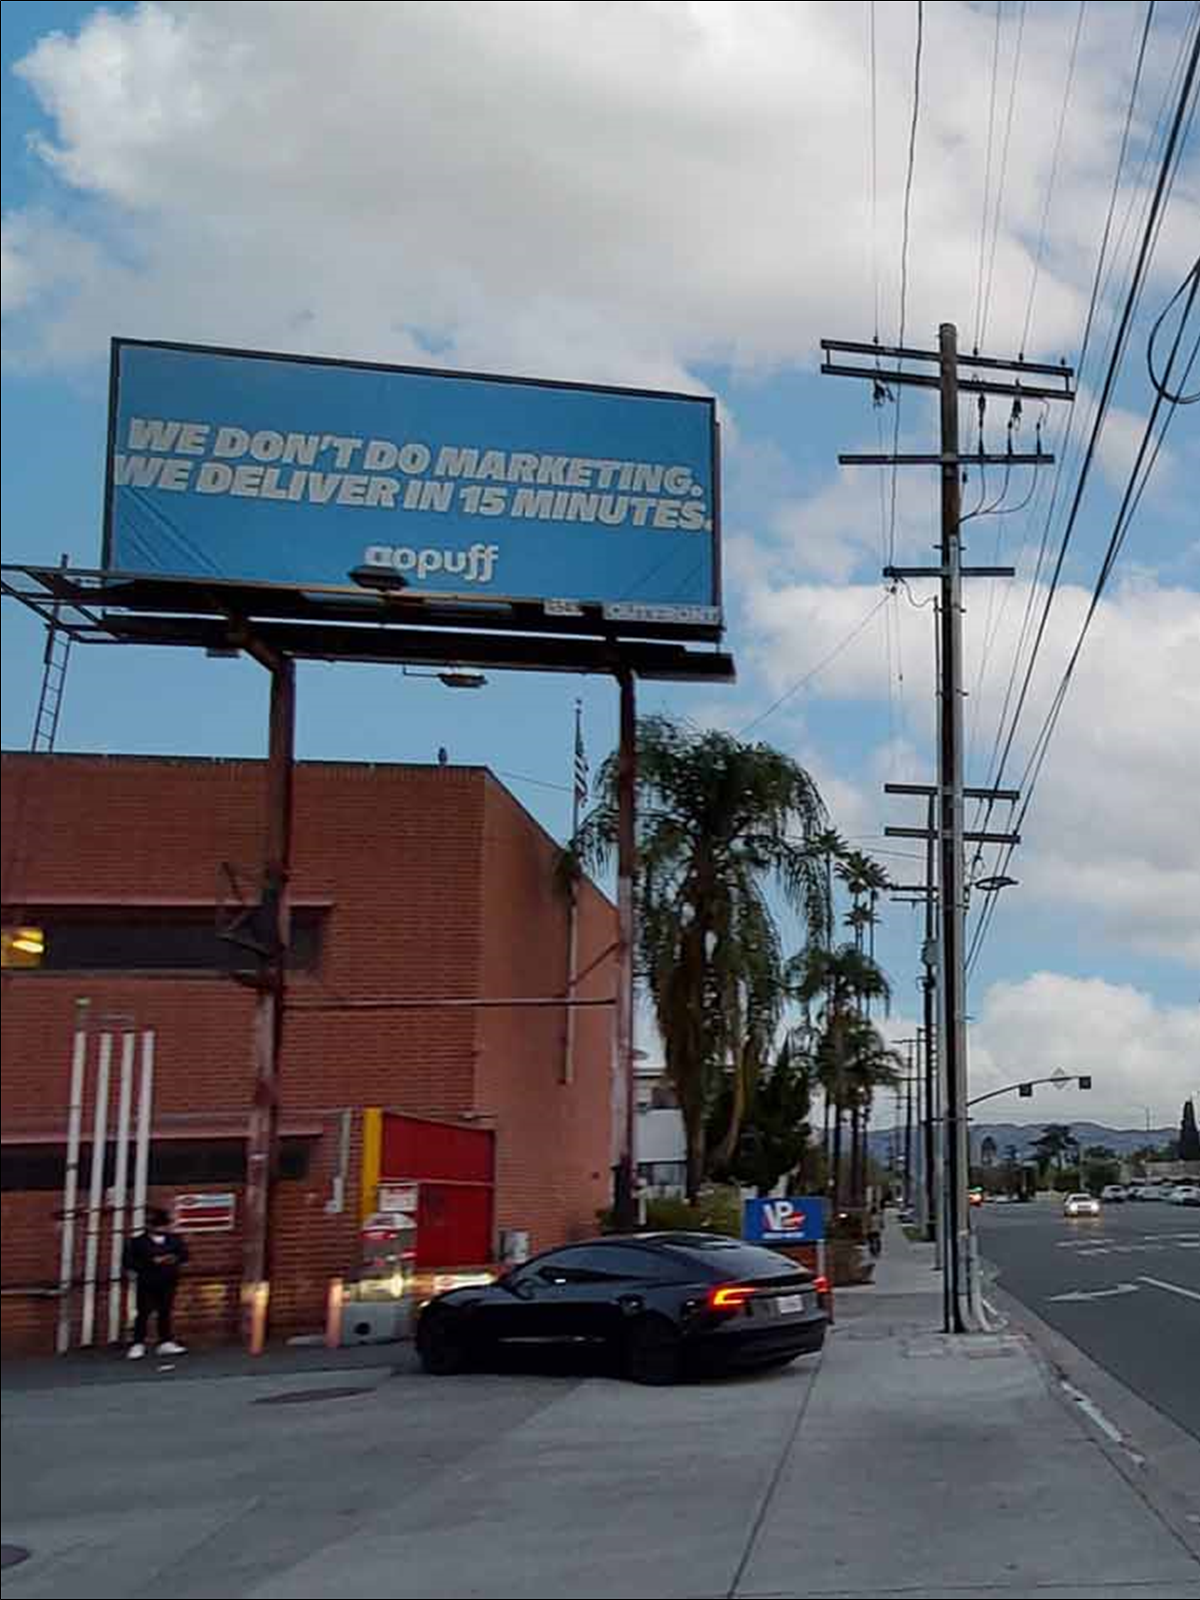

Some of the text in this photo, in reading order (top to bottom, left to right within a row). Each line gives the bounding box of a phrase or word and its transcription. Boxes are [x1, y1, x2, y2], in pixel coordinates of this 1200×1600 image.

[114, 454, 713, 531] WE DELIVER IN 15 MINUTES.
[128, 417, 703, 496] WE DON'T DO MARKETING.
